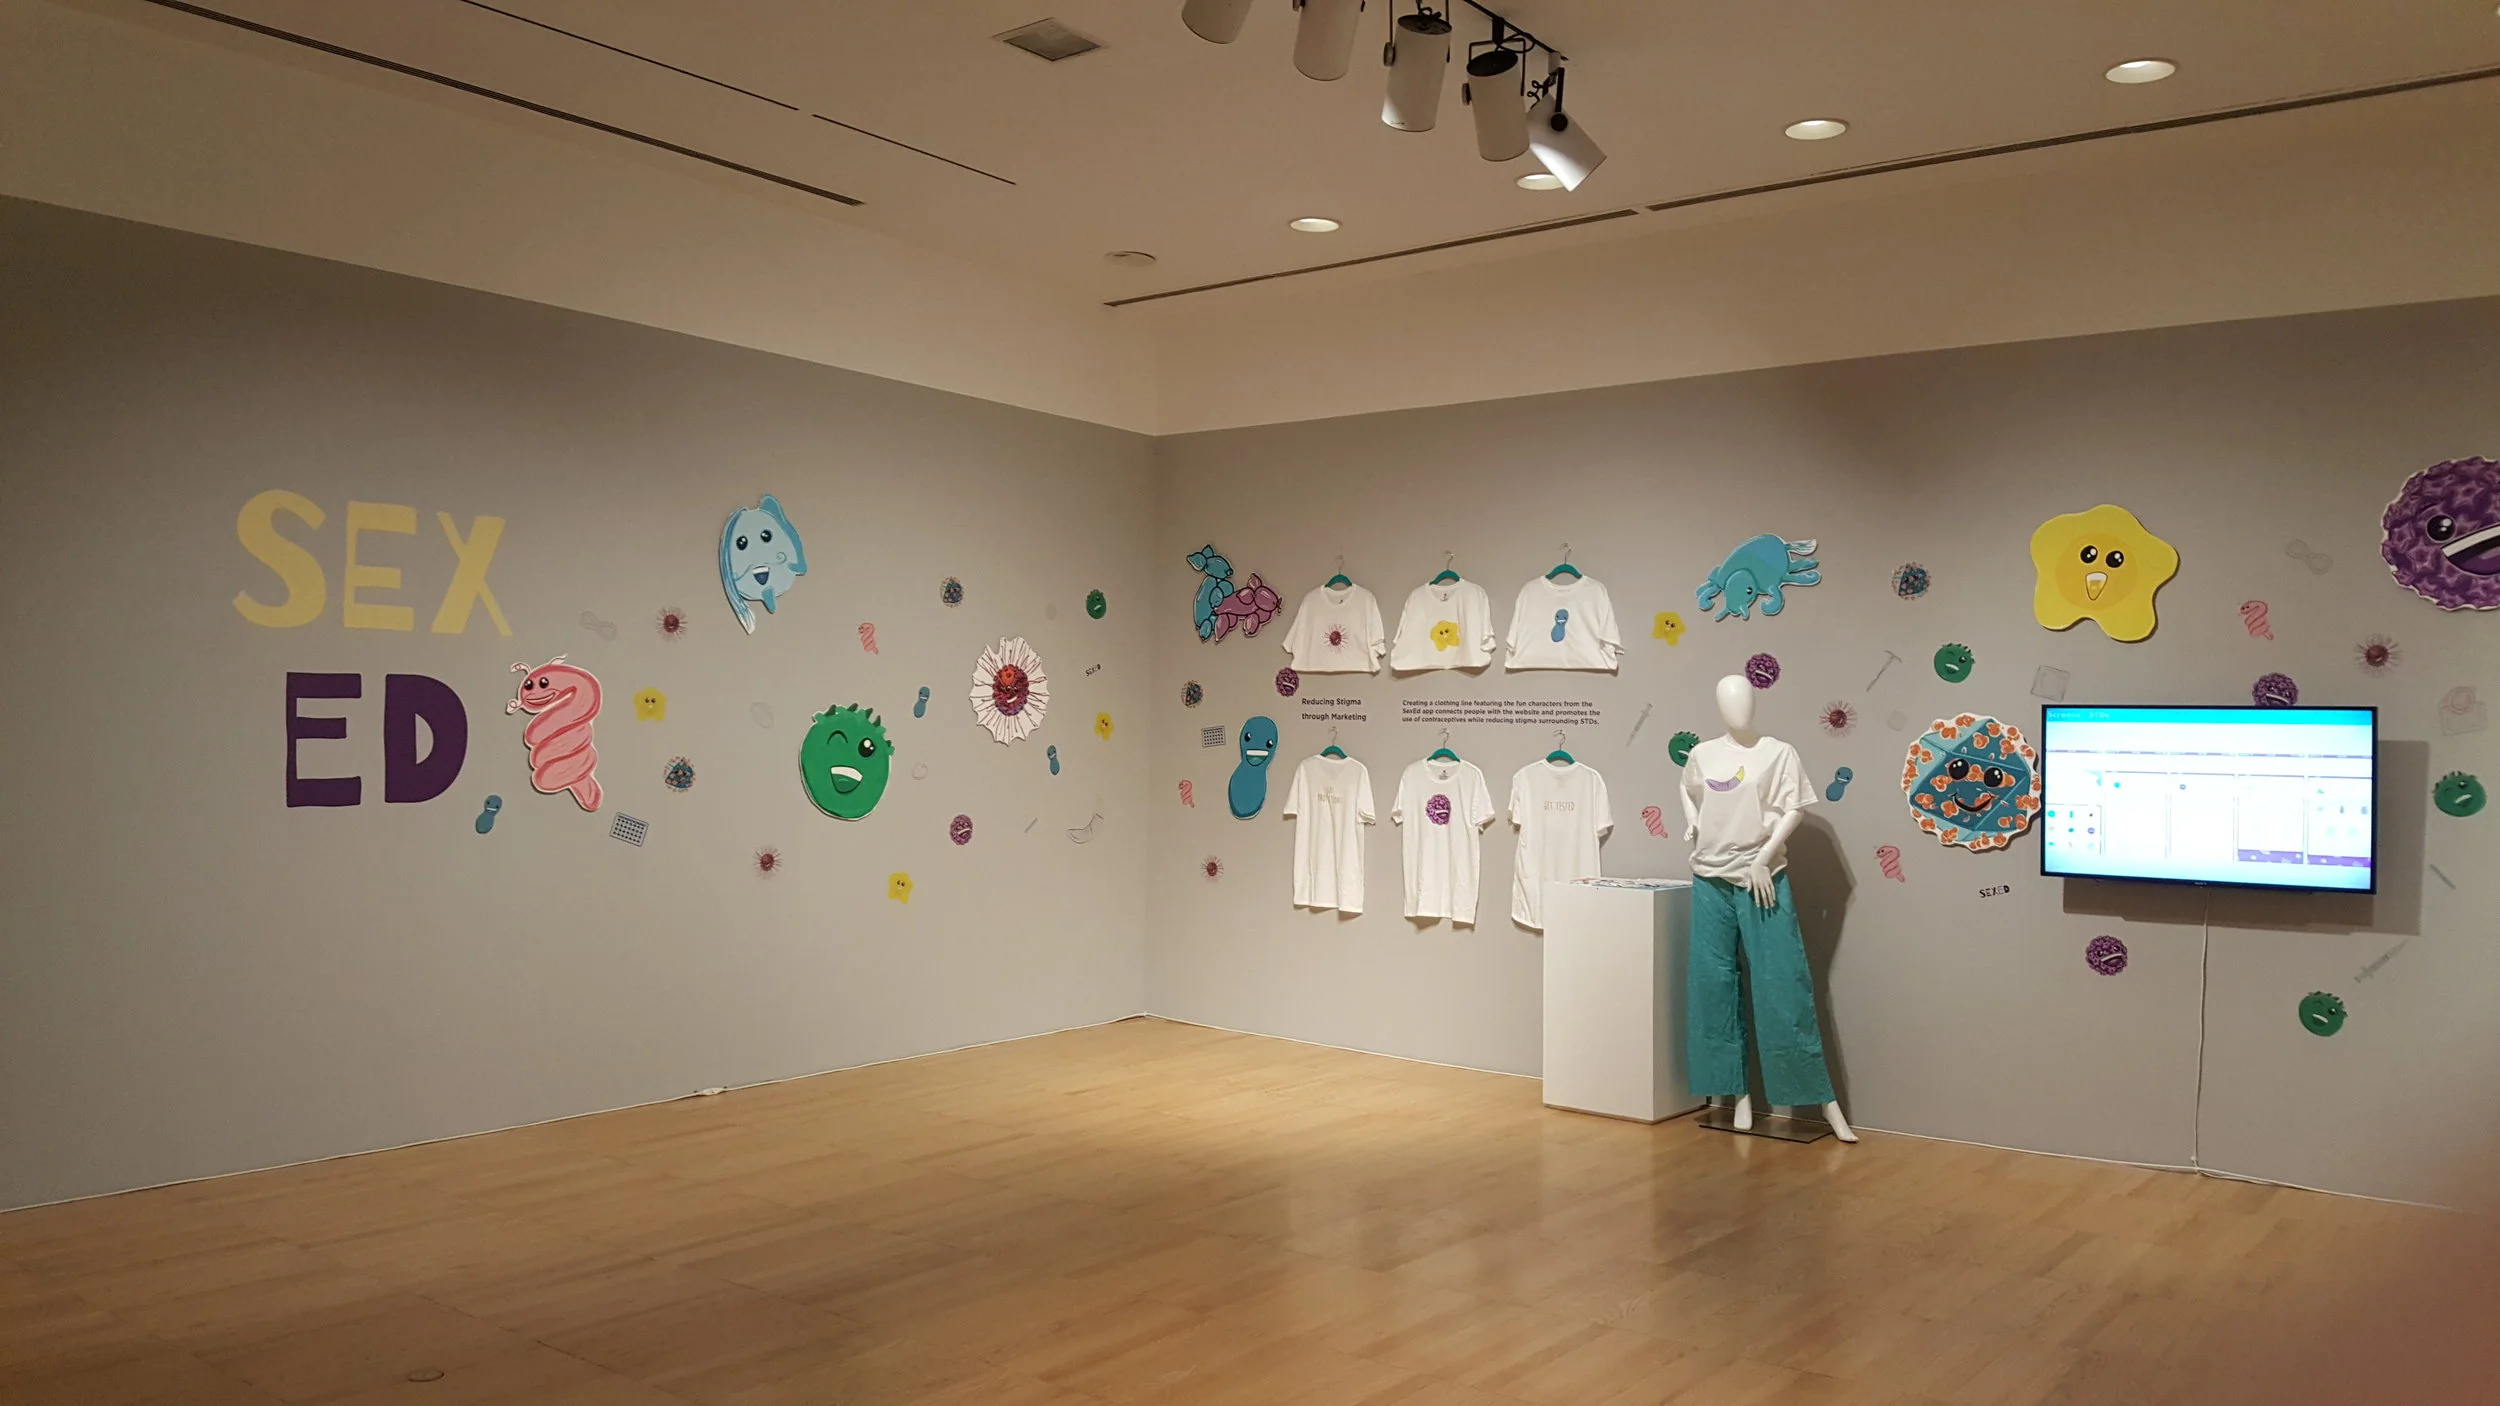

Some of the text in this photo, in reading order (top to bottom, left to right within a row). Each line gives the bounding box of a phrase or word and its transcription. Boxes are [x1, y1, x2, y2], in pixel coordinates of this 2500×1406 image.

[232, 489, 513, 637] SEX
[1301, 698, 1362, 706] Reducing Stigma
[1474, 700, 1502, 708] featuring
[1301, 713, 1367, 722] through Marketing
[1539, 718, 1579, 726] surrounding
[286, 672, 468, 807] ED
[1979, 884, 2010, 898] SEXED
